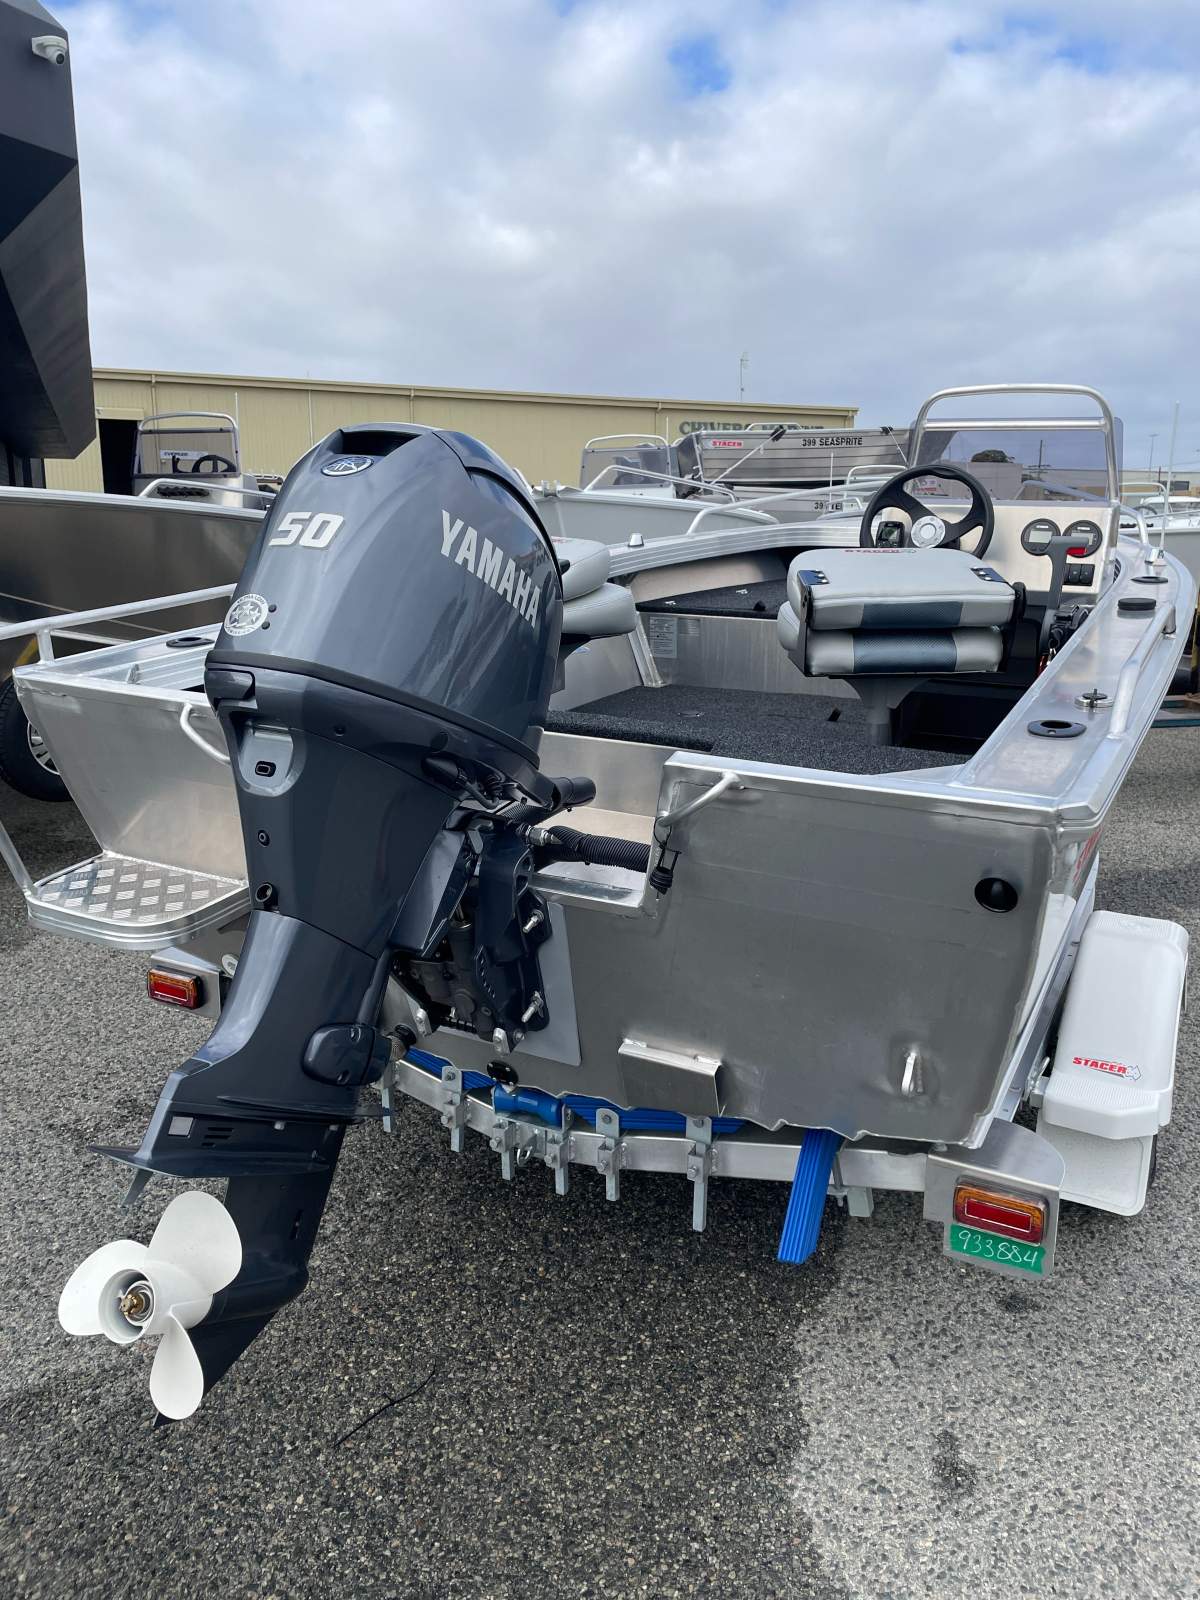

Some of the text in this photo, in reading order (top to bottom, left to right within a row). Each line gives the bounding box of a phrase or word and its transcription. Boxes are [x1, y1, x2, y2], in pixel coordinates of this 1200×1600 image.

[802, 437, 863, 447] 399 SEASPRITE
[269, 511, 345, 549] 50
[440, 509, 542, 629] YAMAHA
[1072, 1056, 1128, 1075] STACER
[958, 1230, 1038, 1267] 933884
